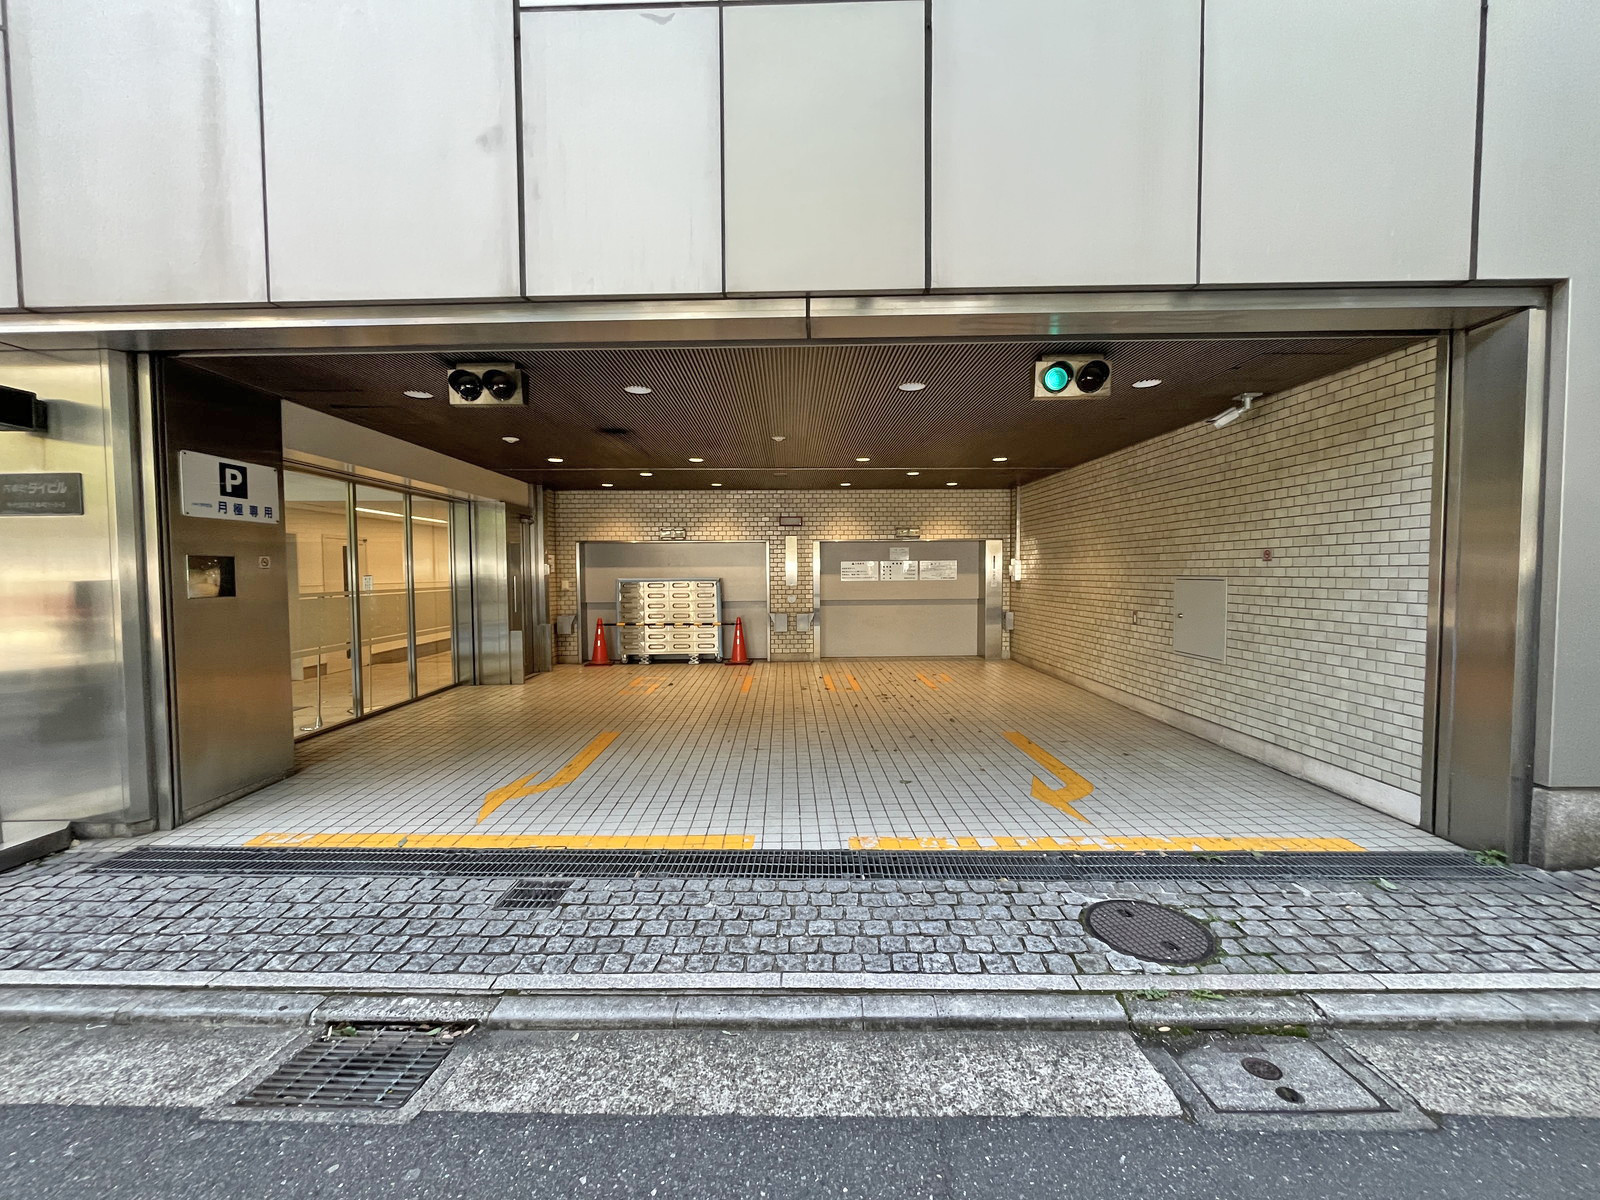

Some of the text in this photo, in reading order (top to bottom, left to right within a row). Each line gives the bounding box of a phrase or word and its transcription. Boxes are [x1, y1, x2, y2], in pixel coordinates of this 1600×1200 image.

[225, 468, 243, 493] P
[218, 501, 273, 519] 月極専用
